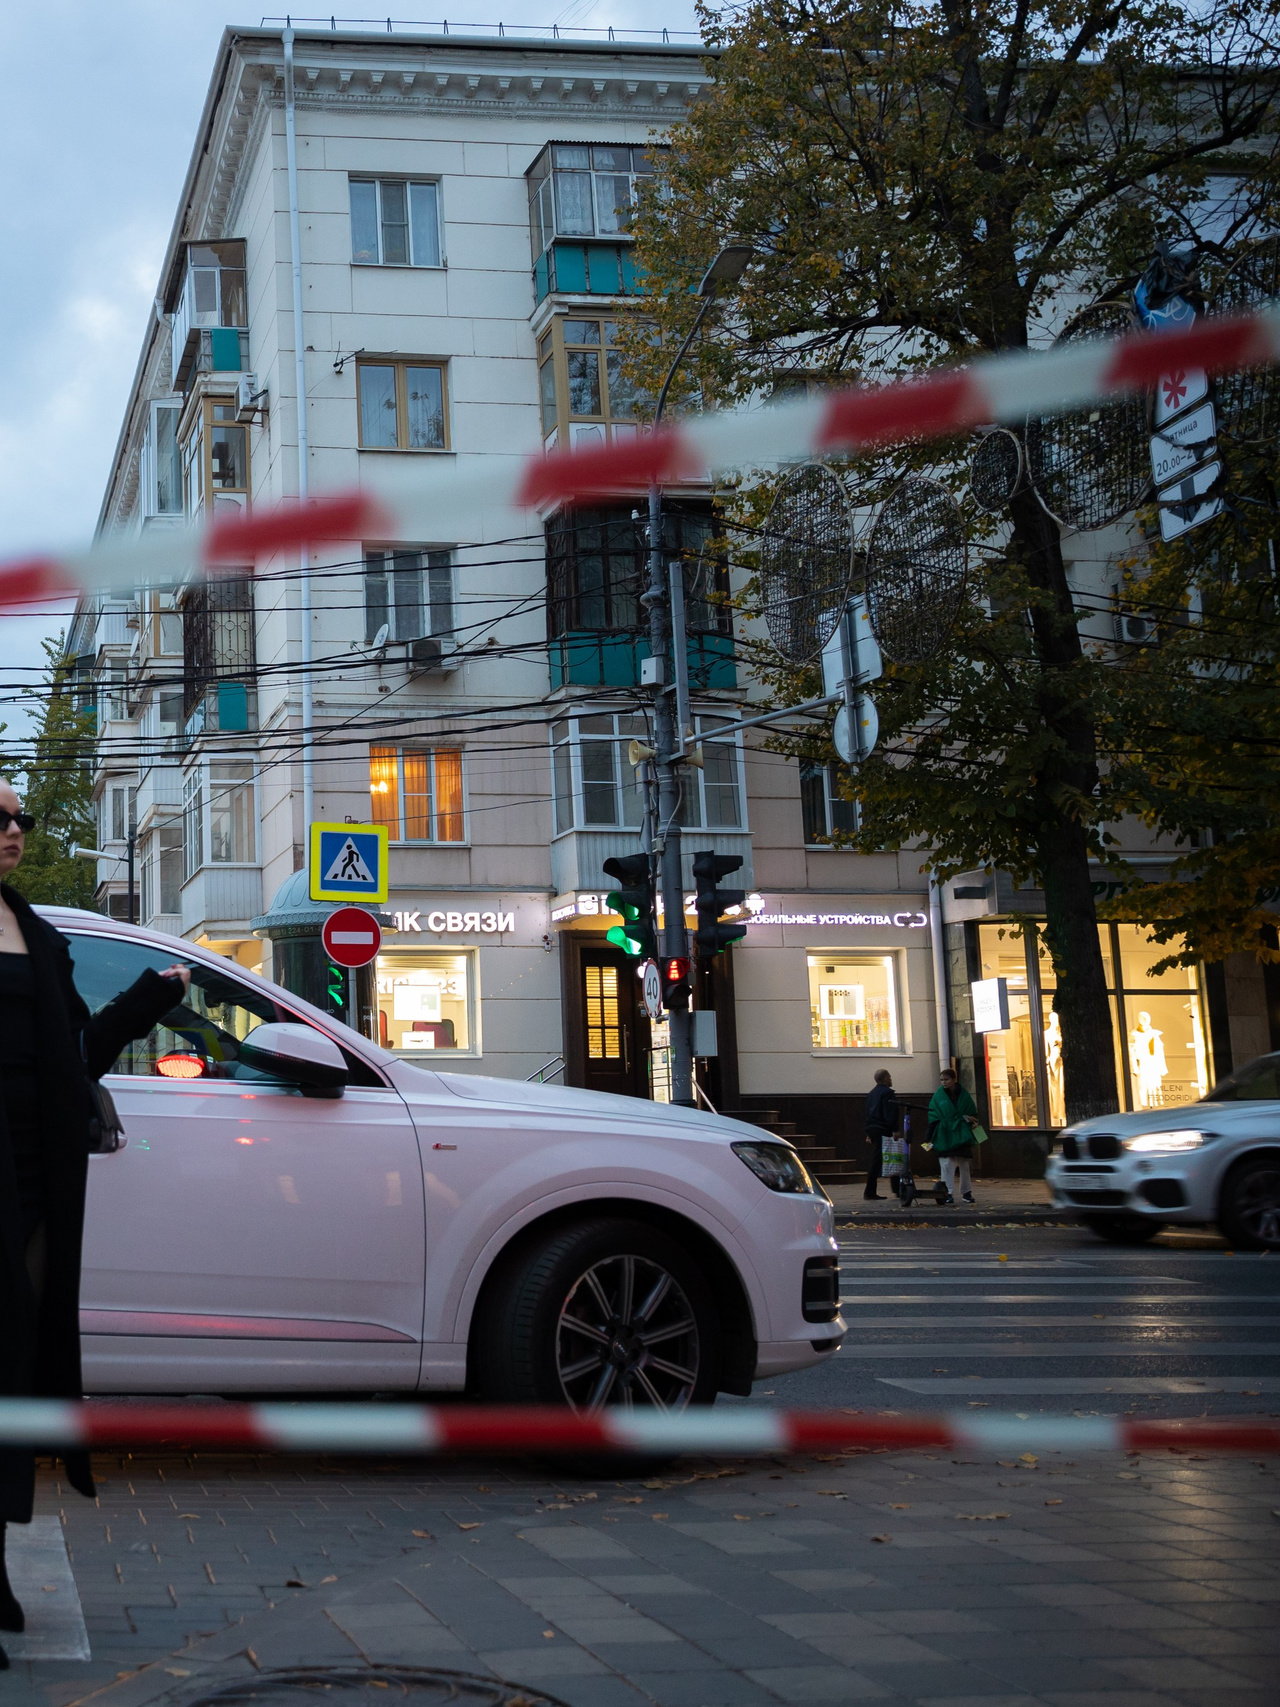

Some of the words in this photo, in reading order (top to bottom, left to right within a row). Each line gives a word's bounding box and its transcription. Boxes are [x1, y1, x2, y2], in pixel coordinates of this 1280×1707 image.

[427, 911, 515, 932] СВЯЗИ
[819, 912, 892, 926] УСТРОЙСТВА
[647, 977, 658, 1000] 40
